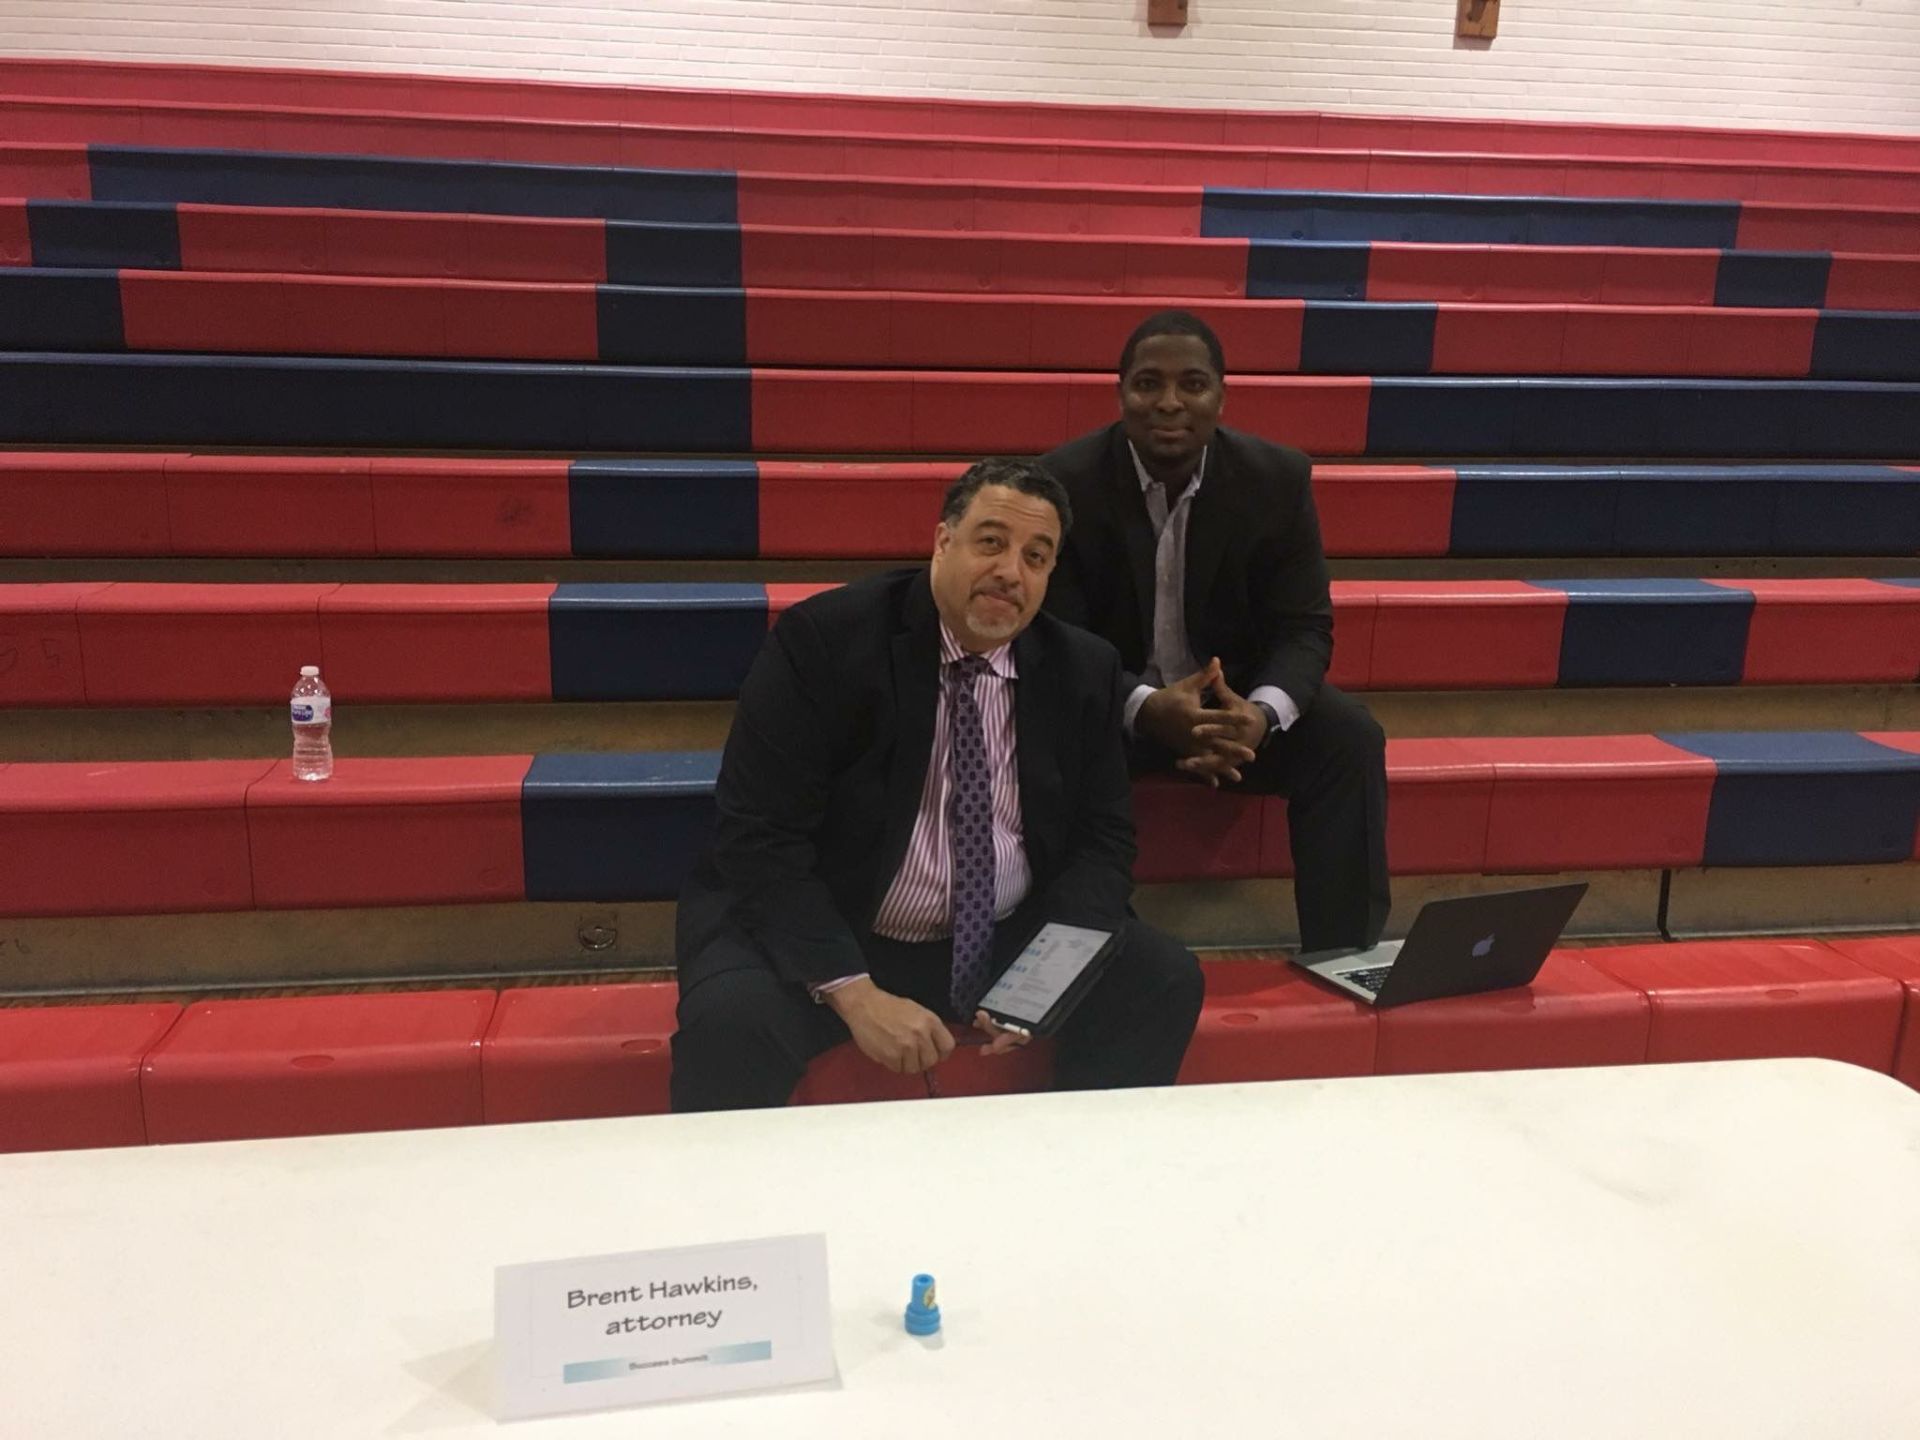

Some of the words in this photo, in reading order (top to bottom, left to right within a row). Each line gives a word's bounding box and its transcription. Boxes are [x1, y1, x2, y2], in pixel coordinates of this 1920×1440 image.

[567, 1286, 643, 1309] Brent
[649, 1275, 758, 1300] Hawkins,
[605, 1309, 722, 1335] attorney
